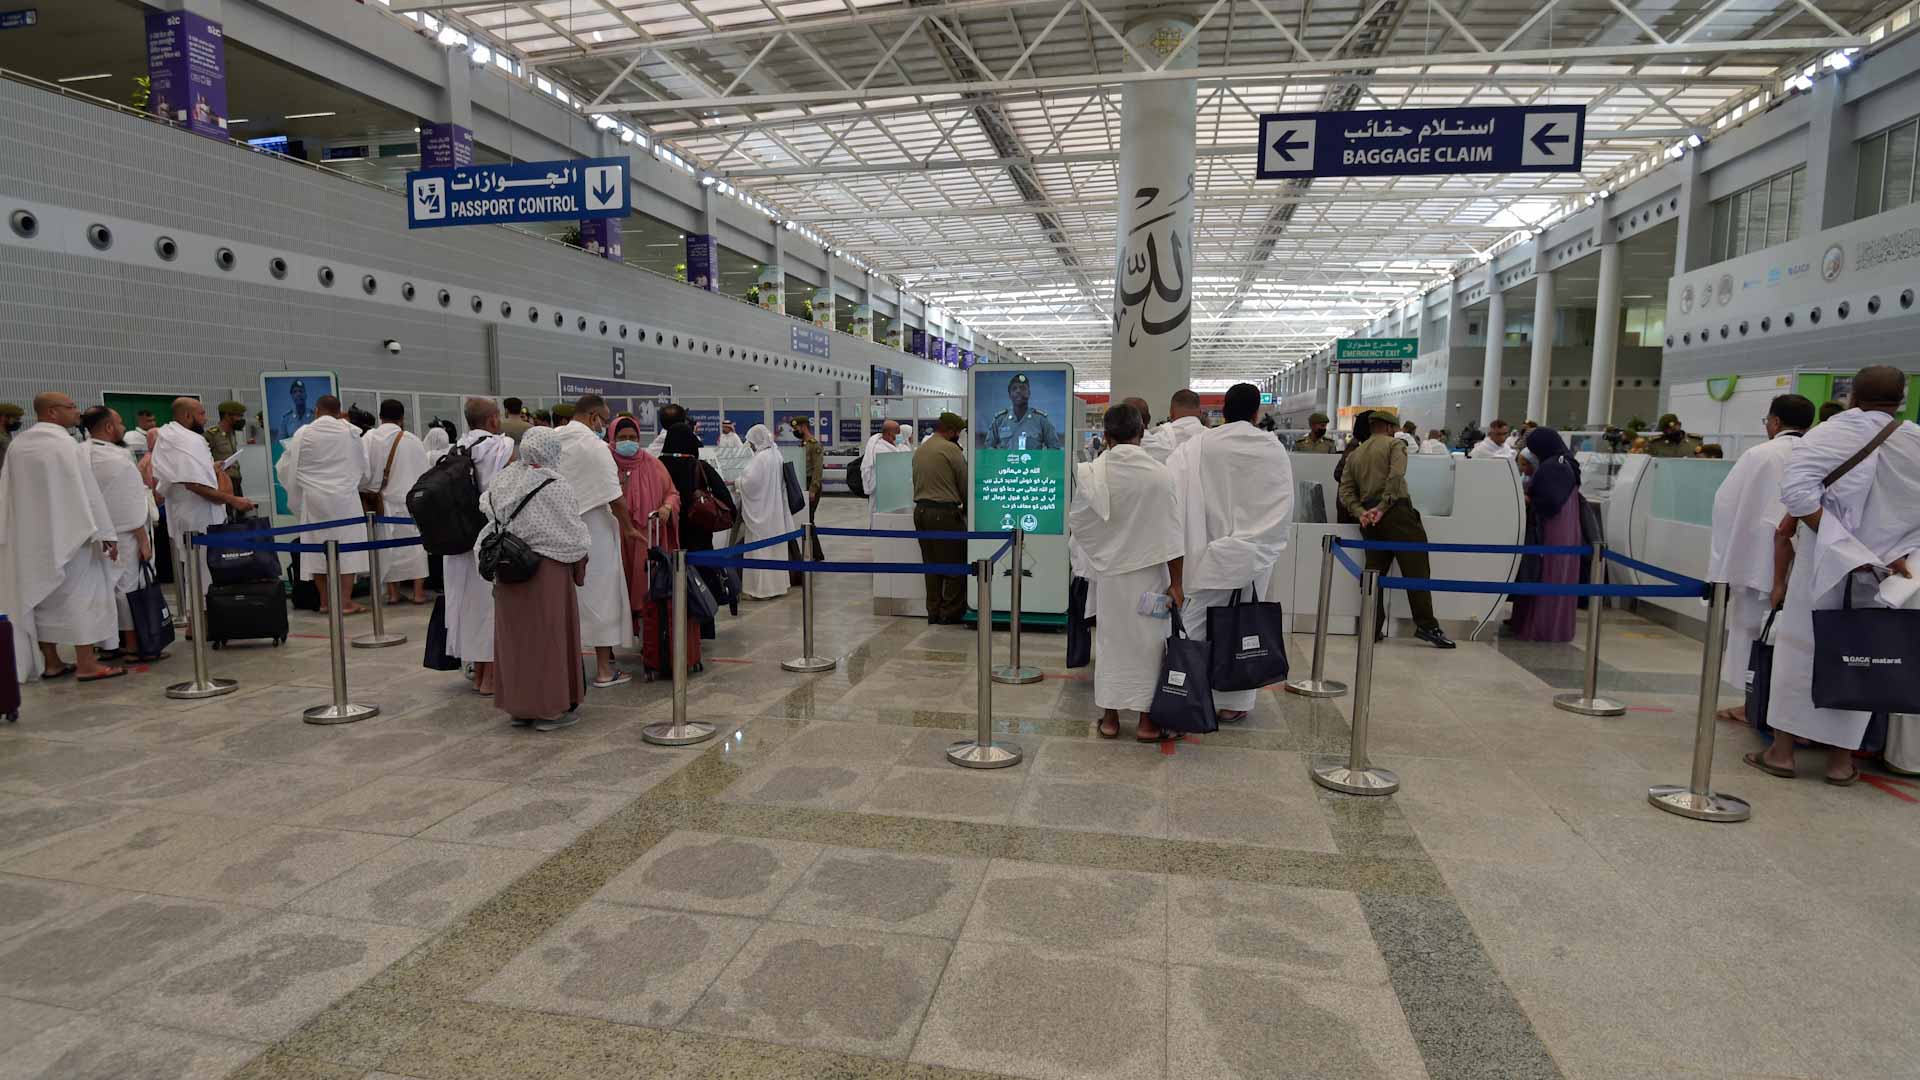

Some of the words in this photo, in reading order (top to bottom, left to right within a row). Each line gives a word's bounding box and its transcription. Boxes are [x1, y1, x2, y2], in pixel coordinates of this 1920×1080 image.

[1344, 120, 1412, 143] حقائب
[1418, 118, 1494, 143] استلام
[1343, 147, 1430, 165] BAGGAGE
[1434, 146, 1493, 163] CLAIM
[451, 167, 577, 193] الجوازات
[451, 198, 515, 218] PASSPORT
[519, 195, 579, 214] CONTROL
[615, 352, 624, 375] 5
